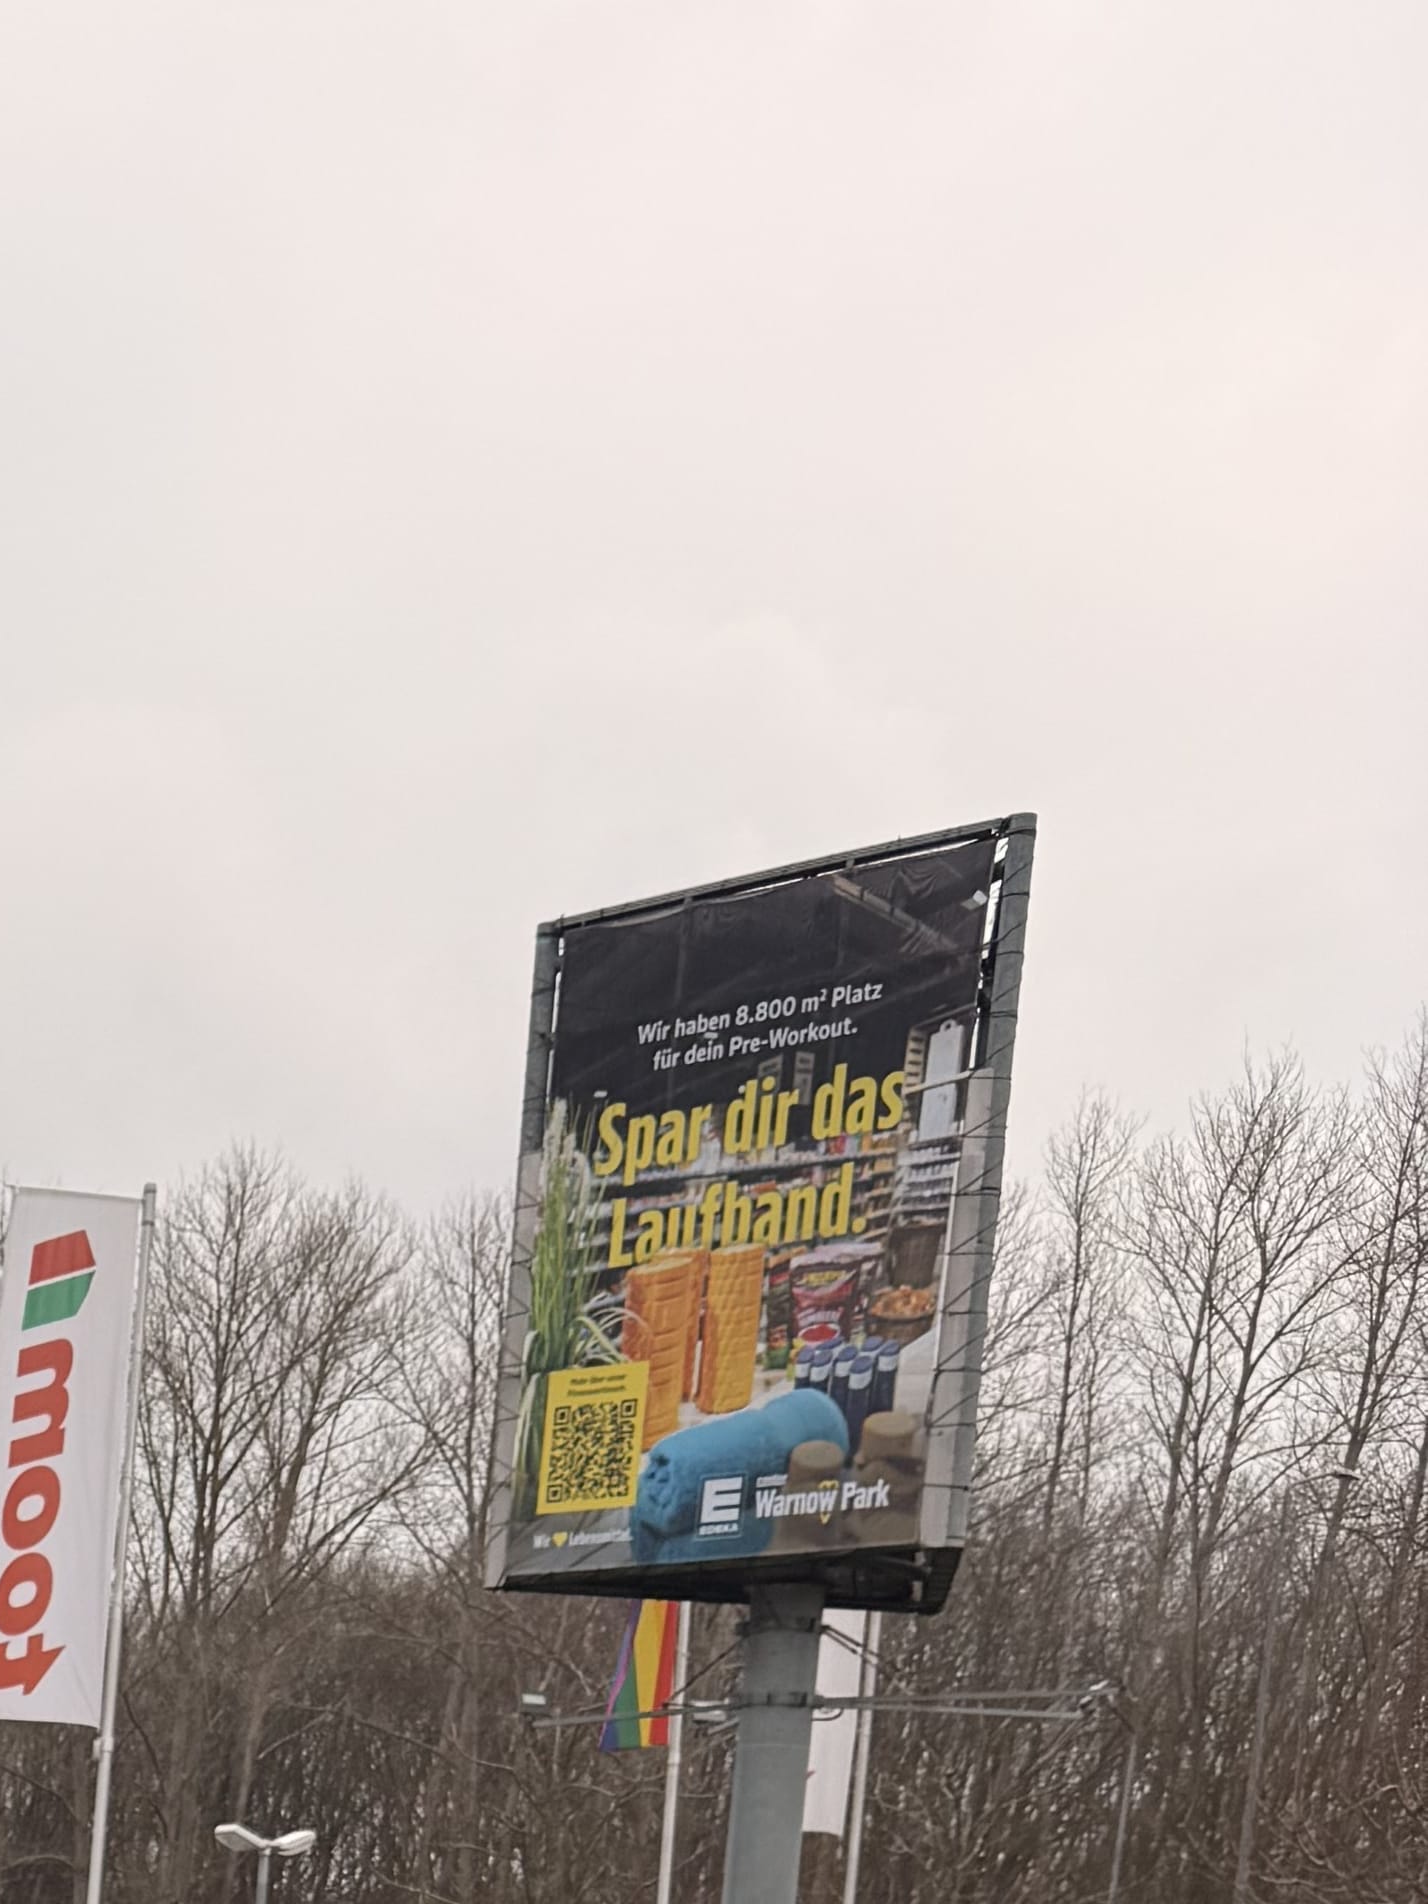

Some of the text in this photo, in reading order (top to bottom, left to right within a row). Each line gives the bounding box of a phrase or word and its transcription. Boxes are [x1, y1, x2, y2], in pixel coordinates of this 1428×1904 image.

[638, 983, 883, 1044] Wir haben 8.800 m² Platz
[653, 1017, 858, 1071] für dein Pre-Workout.
[594, 1063, 905, 1187] Spar dir das
[700, 1476, 742, 1523] E
[756, 1478, 891, 1519] Warnow Park
